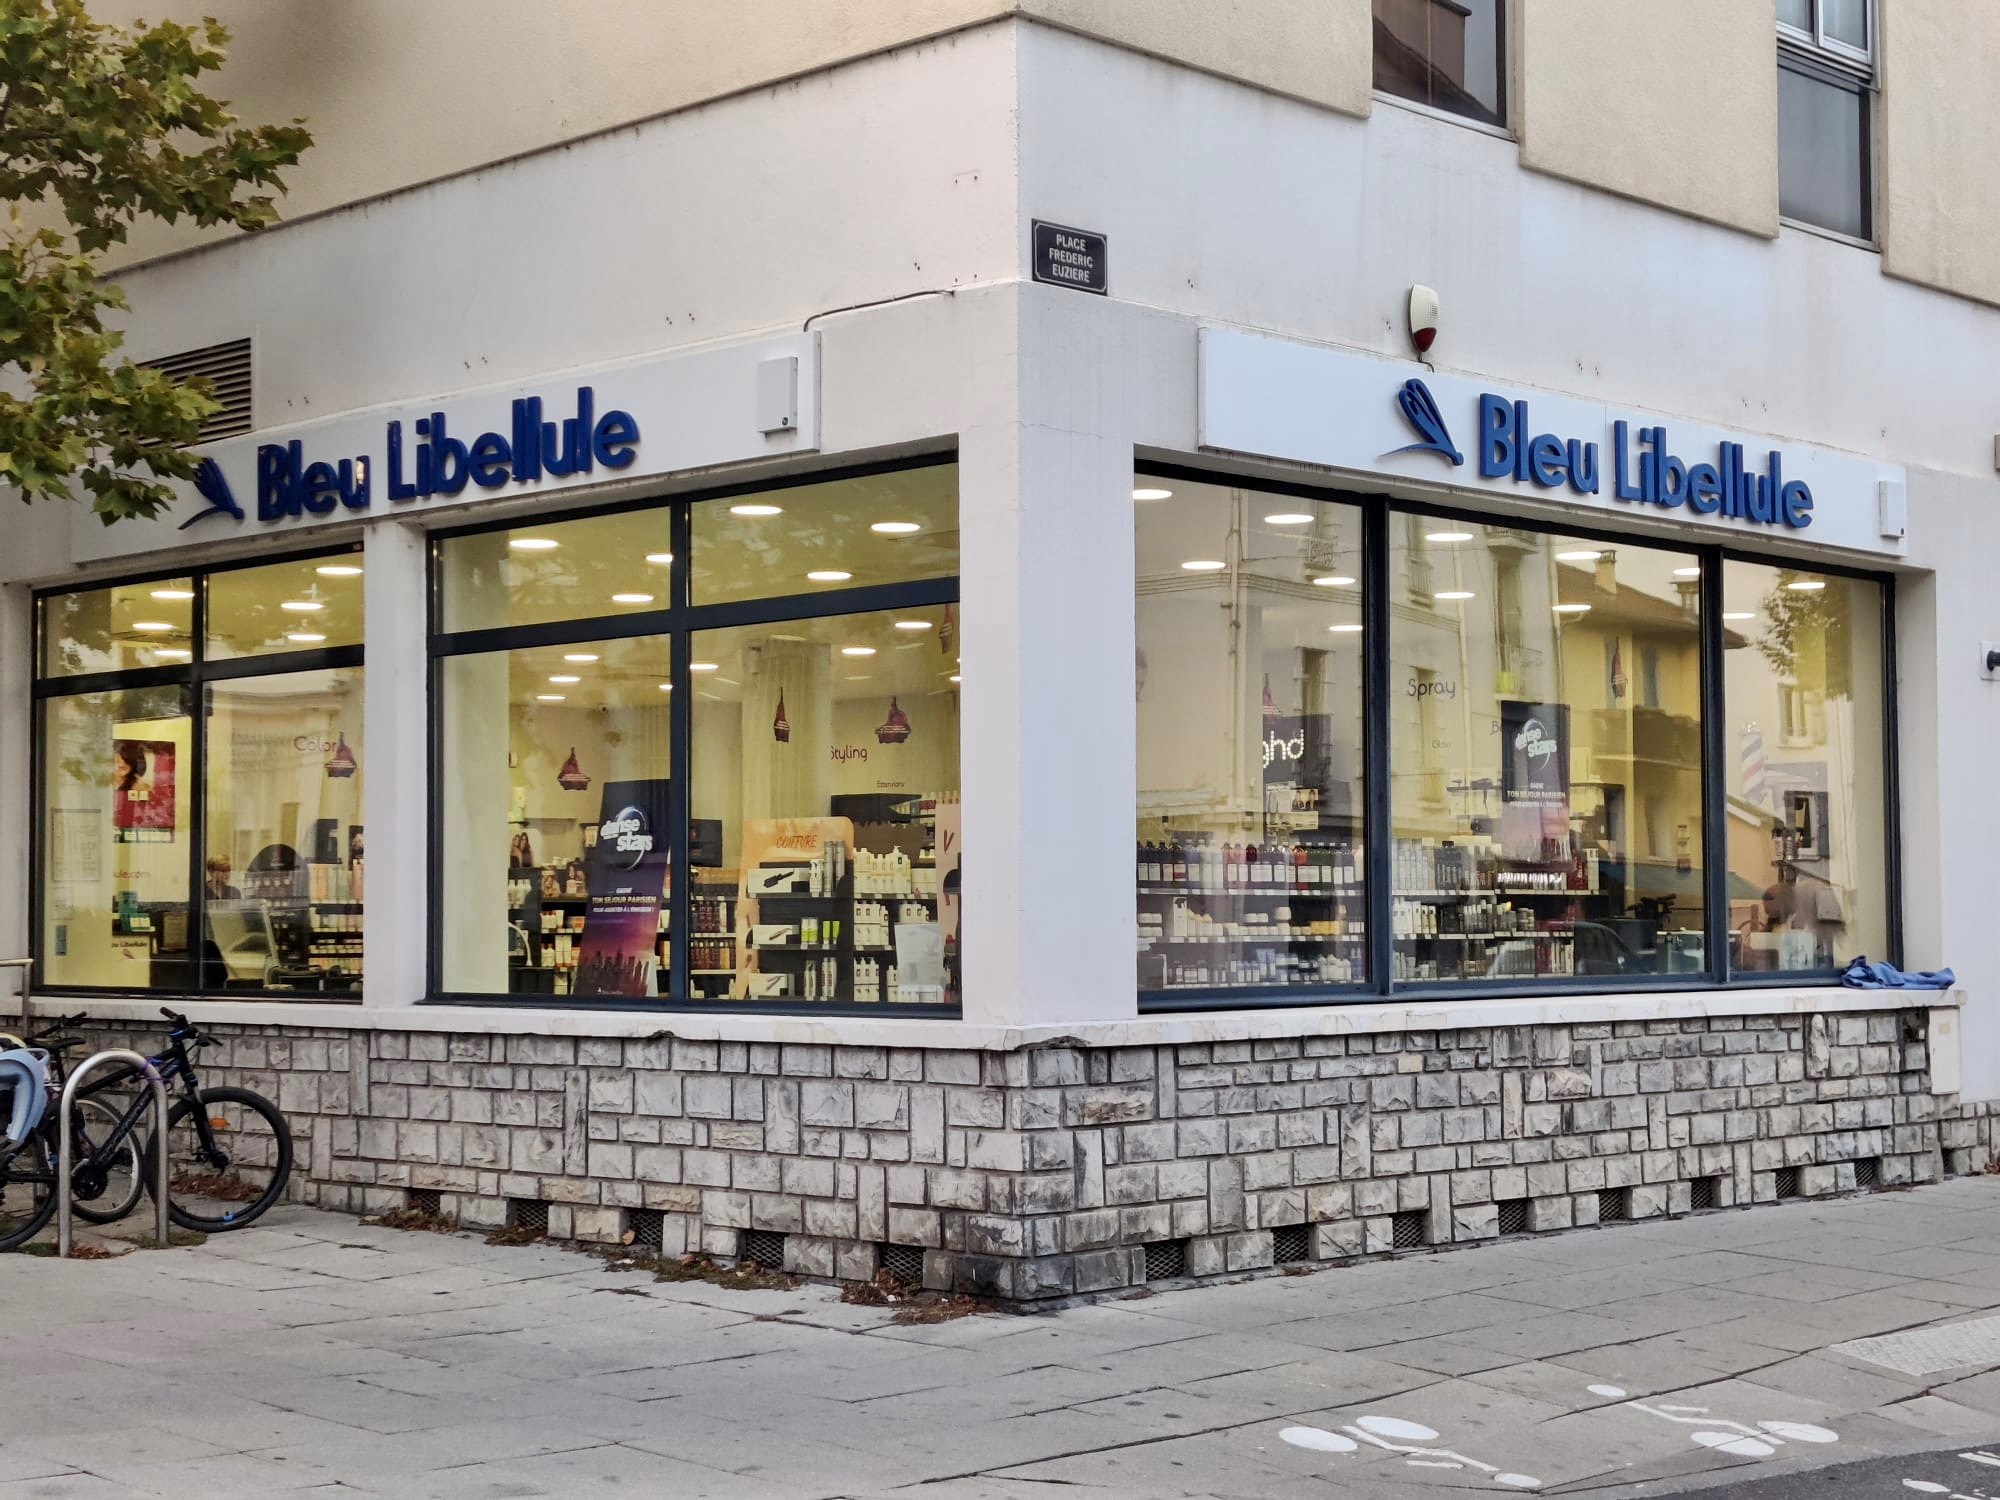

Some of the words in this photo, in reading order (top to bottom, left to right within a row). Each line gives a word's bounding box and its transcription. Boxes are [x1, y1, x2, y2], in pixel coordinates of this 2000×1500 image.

[1056, 233, 1087, 252] PLACE
[1048, 247, 1094, 268] FREDERIC
[1052, 263, 1090, 283] EUZIERE
[257, 439, 371, 522] Bleu
[387, 386, 640, 501] Libellule
[1480, 392, 1599, 494] Bleu
[1614, 420, 1814, 528] Libellule
[1407, 678, 1456, 701] Spray
